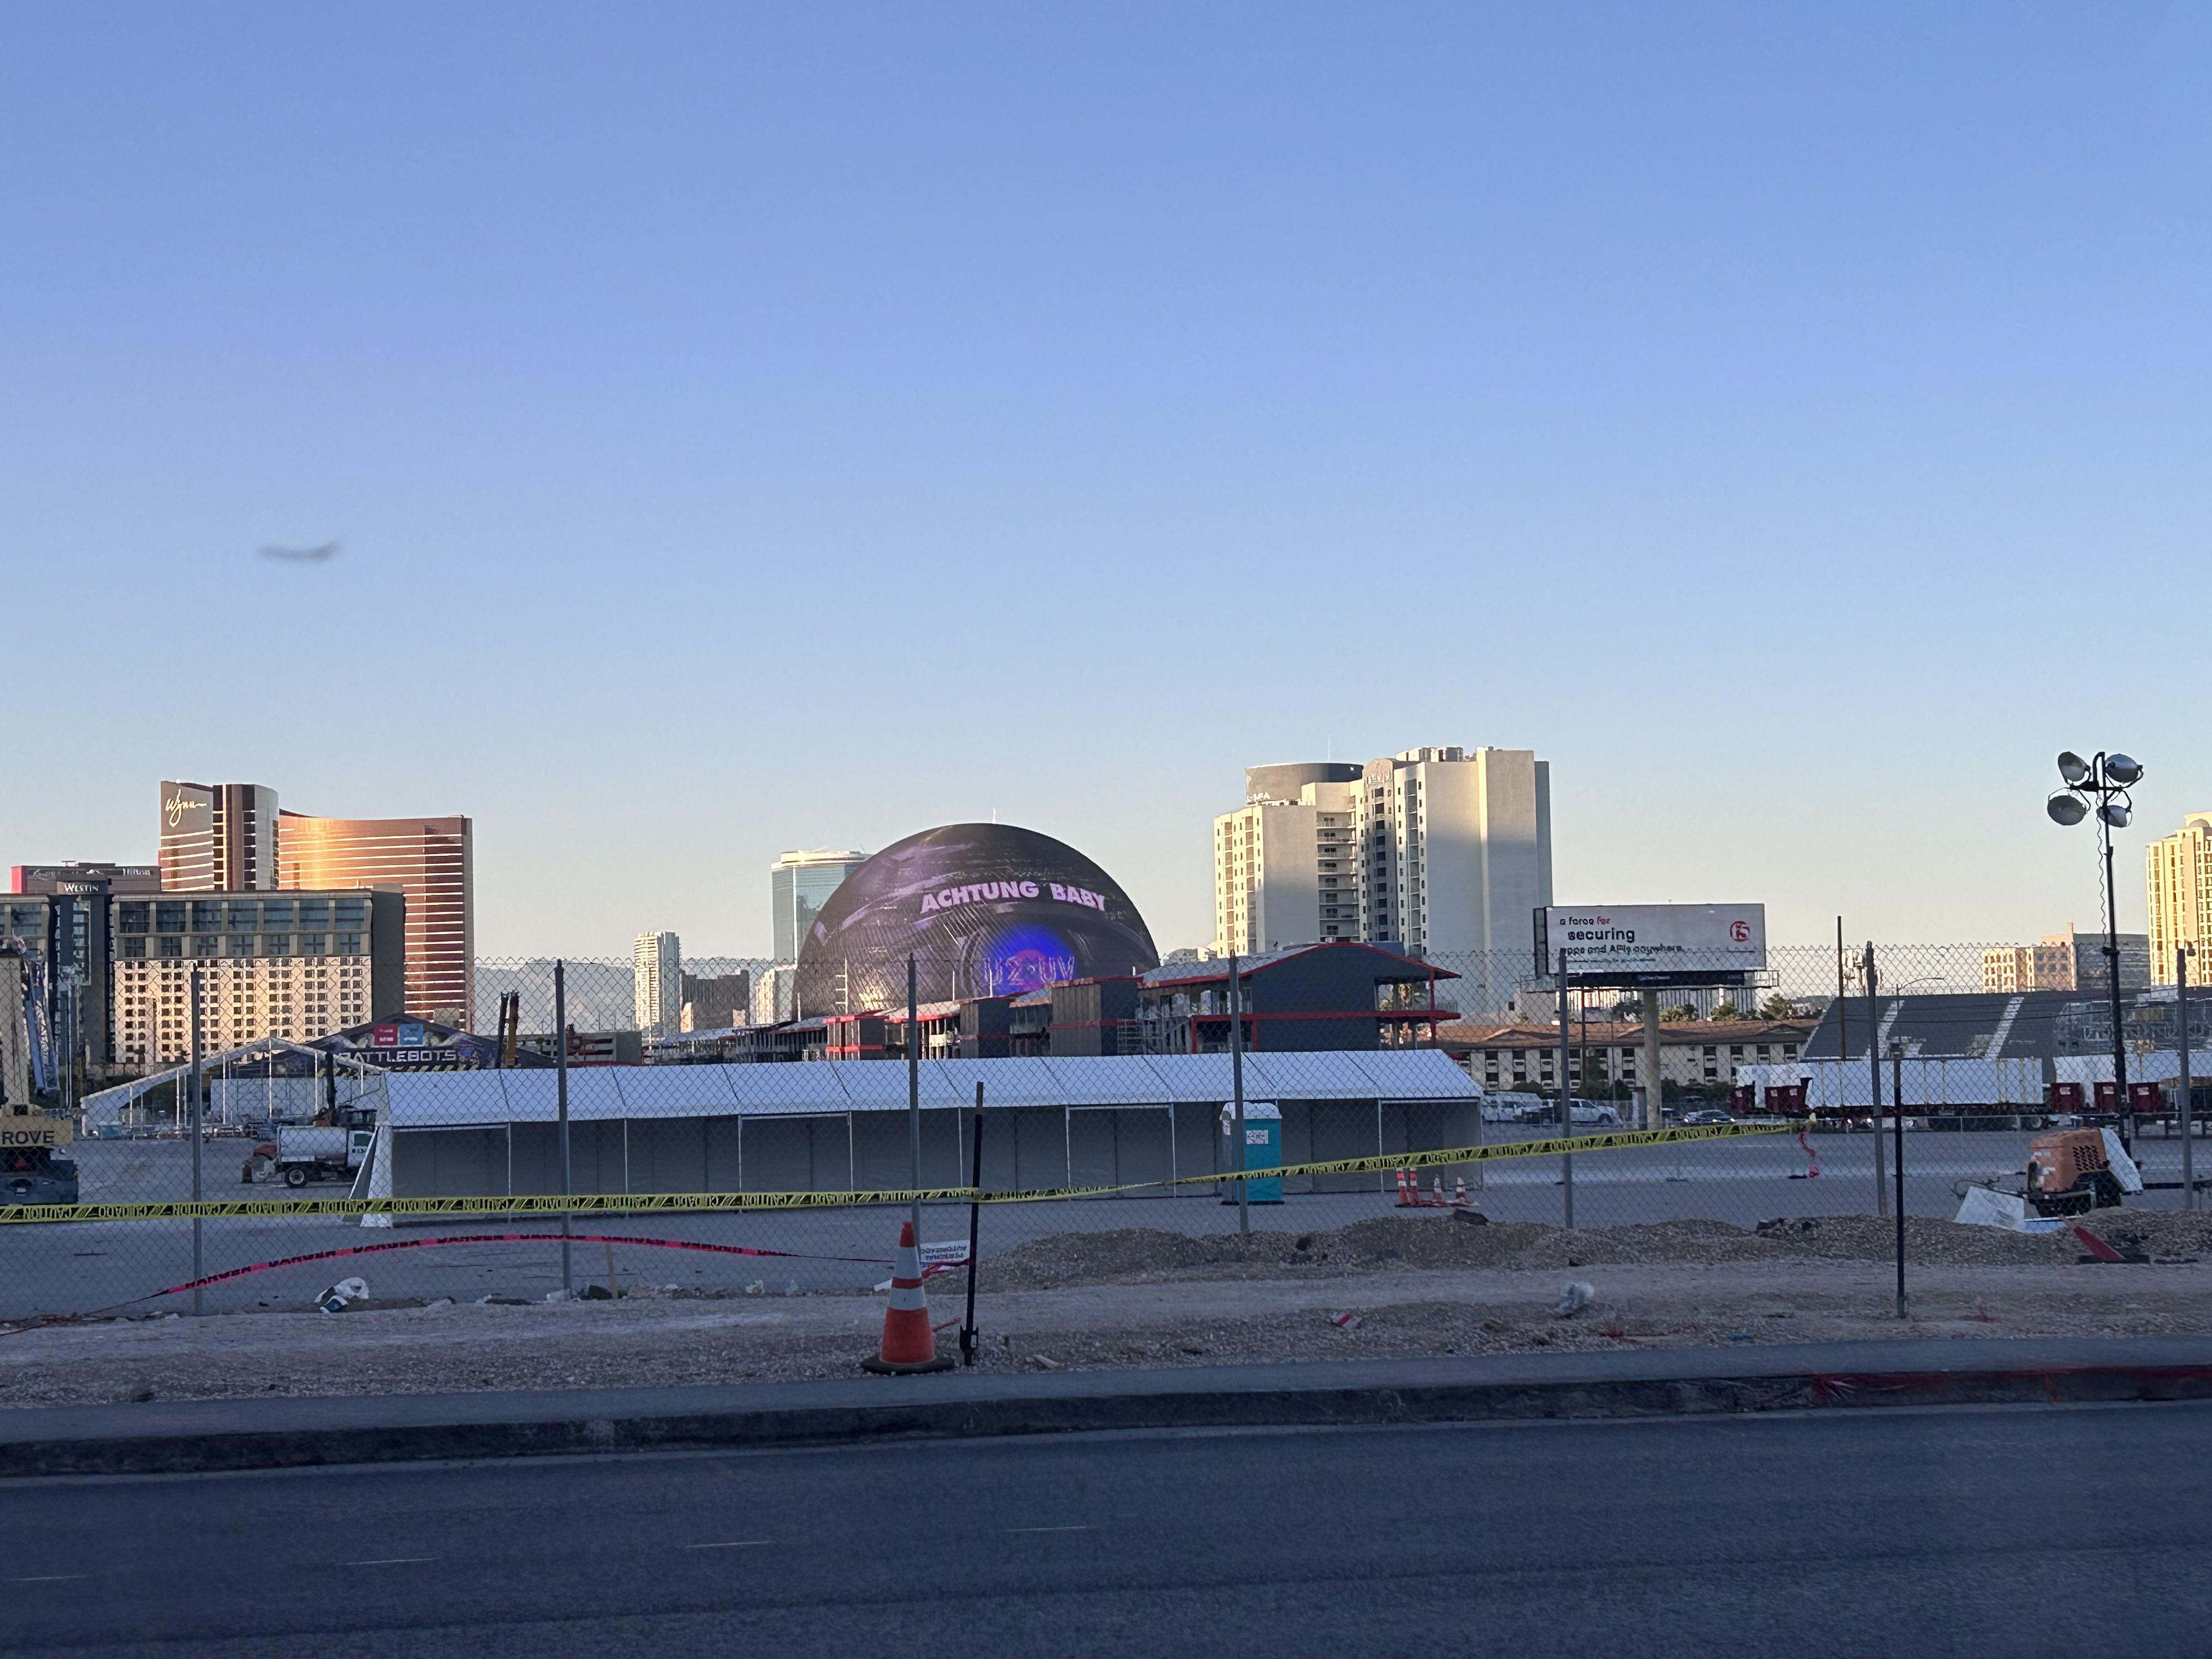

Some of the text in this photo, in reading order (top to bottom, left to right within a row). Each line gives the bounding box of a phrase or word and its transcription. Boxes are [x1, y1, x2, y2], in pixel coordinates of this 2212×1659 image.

[921, 881, 1105, 914] ACHTUNG BABY
[1568, 927, 1635, 943] securing
[2, 1131, 54, 1144] ROVE
